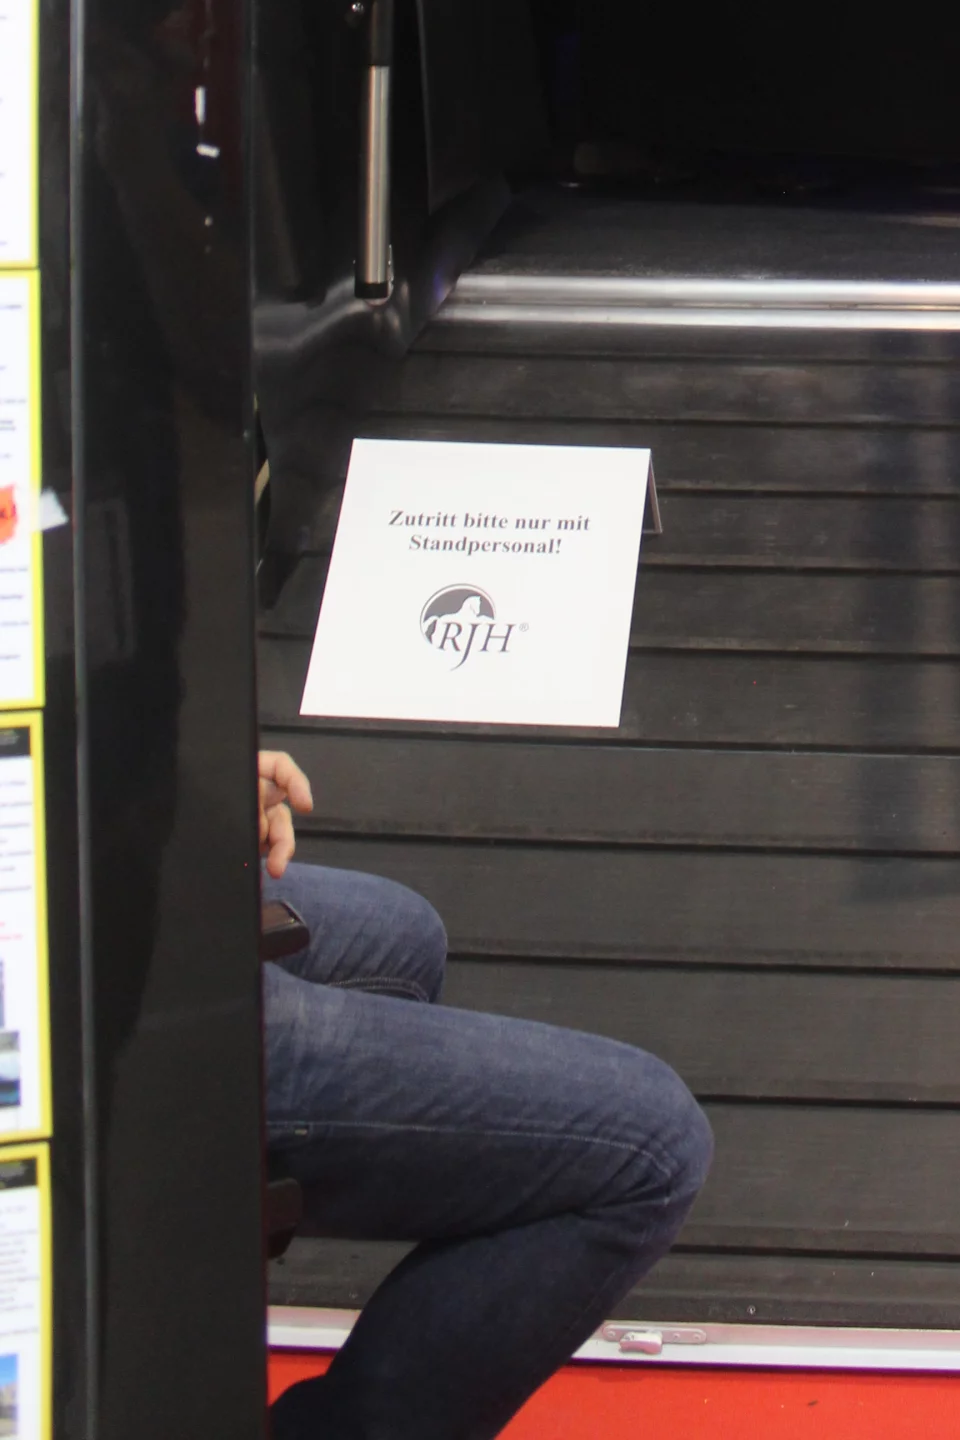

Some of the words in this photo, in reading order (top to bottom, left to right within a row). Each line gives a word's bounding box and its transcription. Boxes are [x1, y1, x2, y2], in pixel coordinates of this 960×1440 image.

[388, 510, 458, 528] Zutritt
[463, 512, 508, 529] bitte
[514, 518, 551, 530] nur
[556, 515, 590, 531] mit
[408, 534, 563, 557] Standpersonal!
